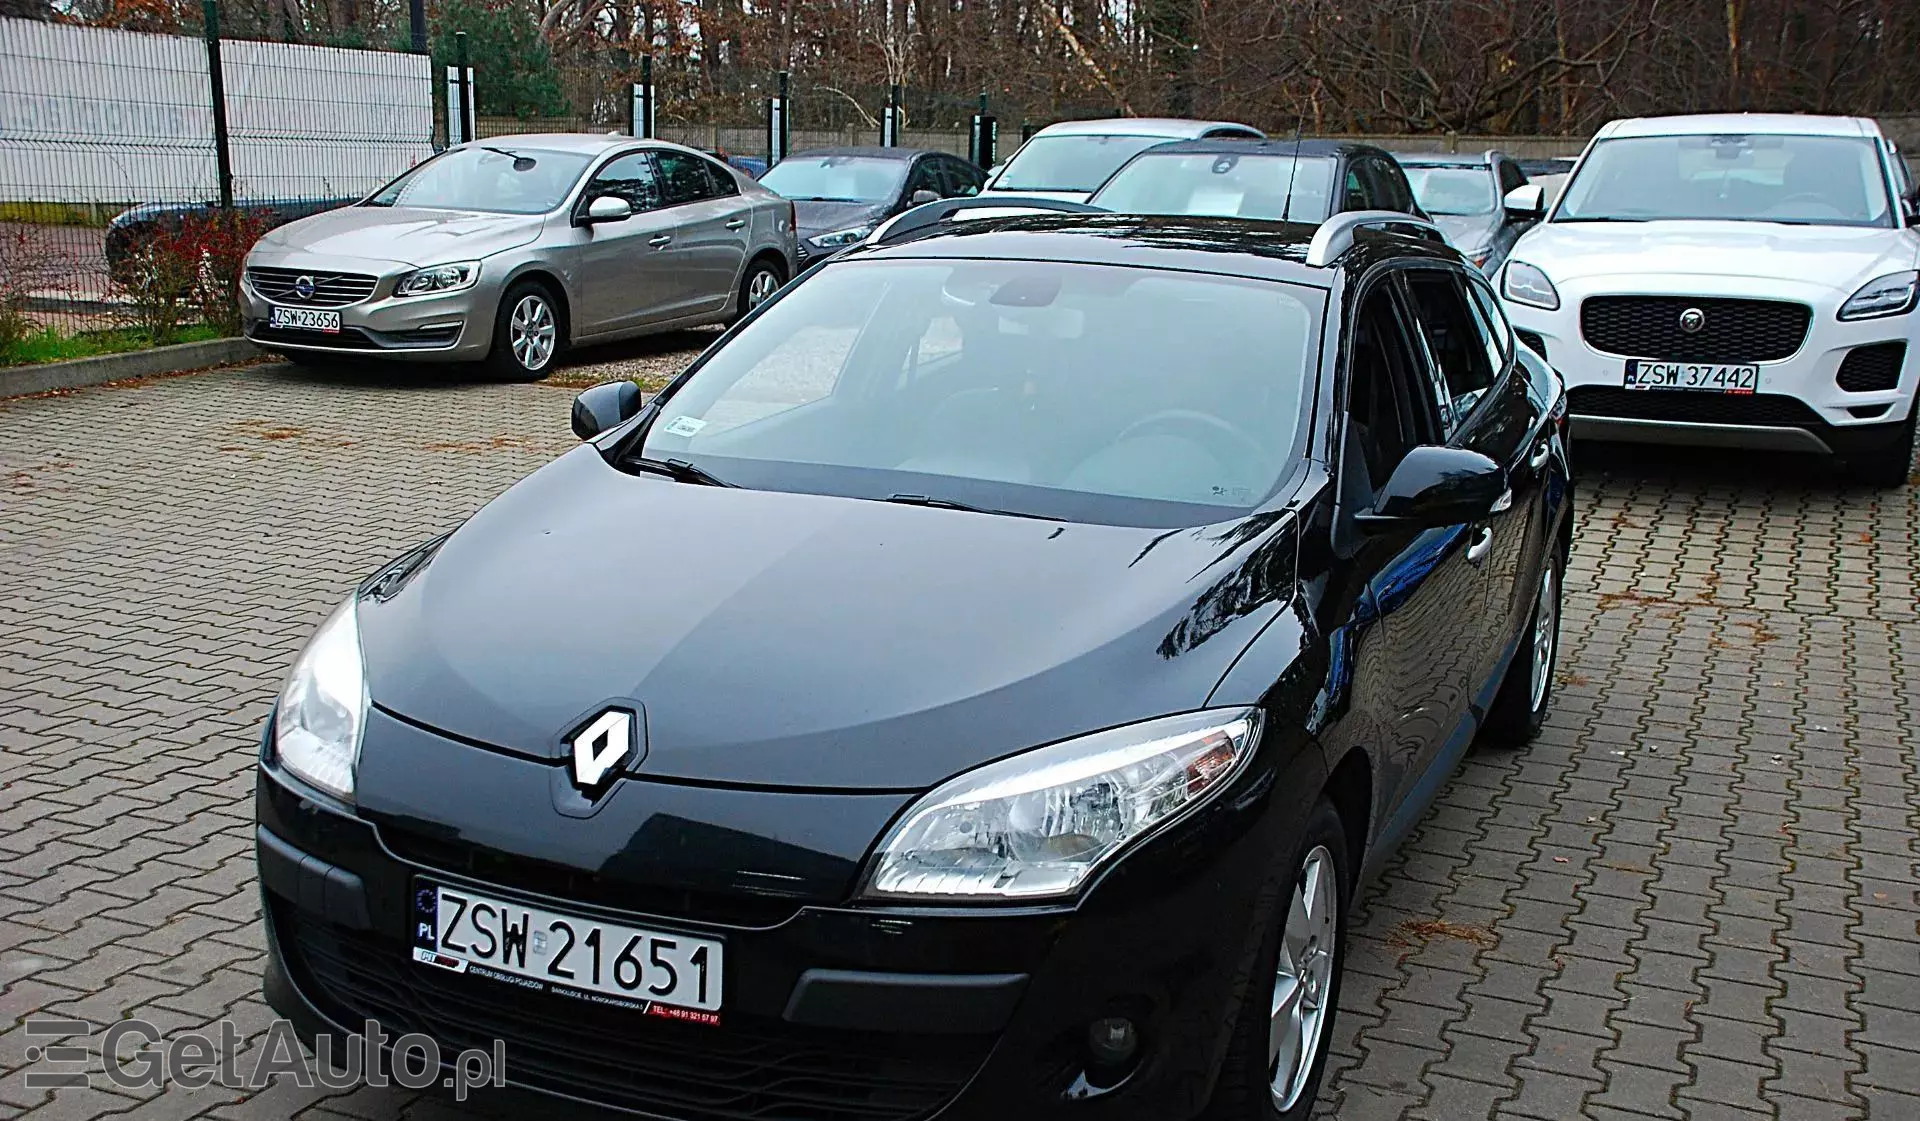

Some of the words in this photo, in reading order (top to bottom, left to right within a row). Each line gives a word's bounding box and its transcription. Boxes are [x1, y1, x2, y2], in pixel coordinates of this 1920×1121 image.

[275, 309, 297, 325] ZSW
[301, 311, 338, 328] 23656
[1638, 364, 1680, 385] ZSW
[1686, 366, 1754, 388] 37442
[419, 922, 435, 940] PL
[441, 893, 529, 968] ZSW
[547, 920, 708, 1003] 21651
